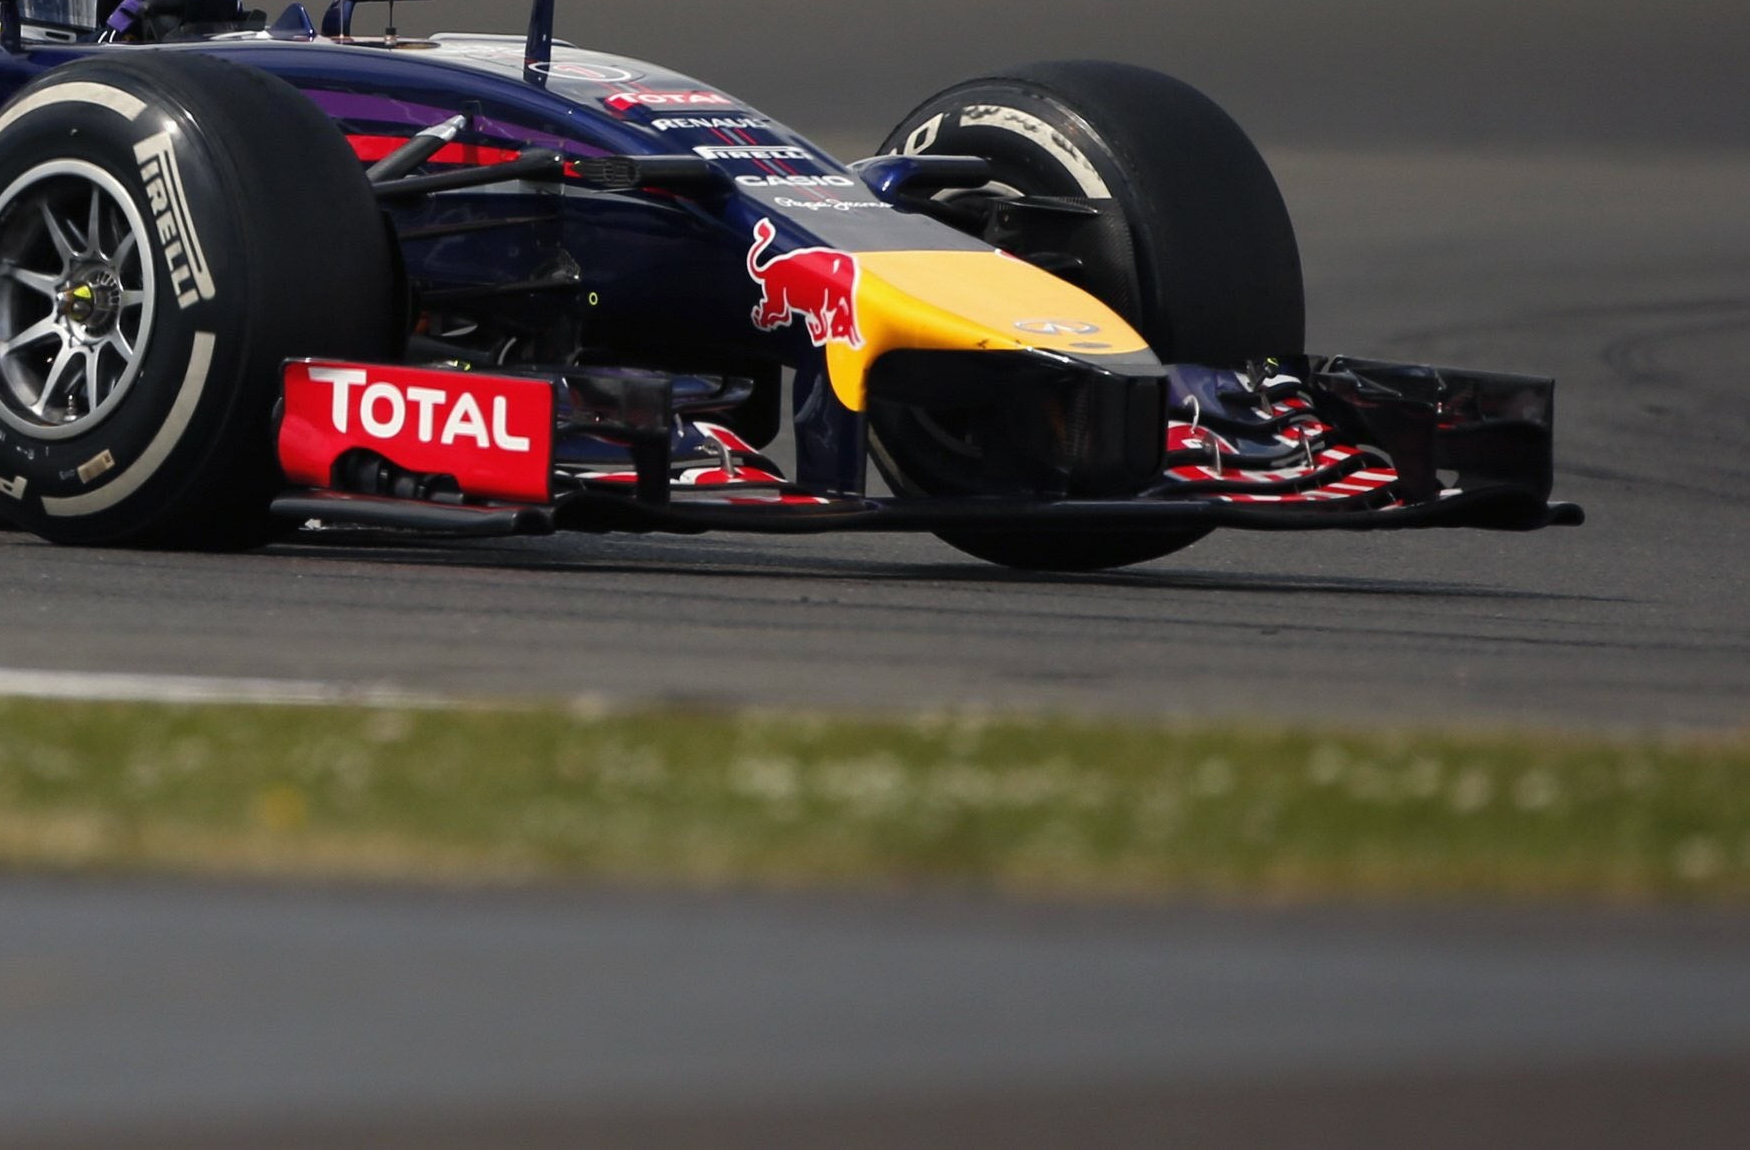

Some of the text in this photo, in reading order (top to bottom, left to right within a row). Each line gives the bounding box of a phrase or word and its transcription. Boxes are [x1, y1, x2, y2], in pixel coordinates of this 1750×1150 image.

[609, 91, 731, 105] TOTAL
[692, 145, 814, 160] PIRELLI
[734, 175, 854, 187] CASIO
[133, 130, 216, 310] PIRELLI
[307, 367, 530, 453] TOTAL
